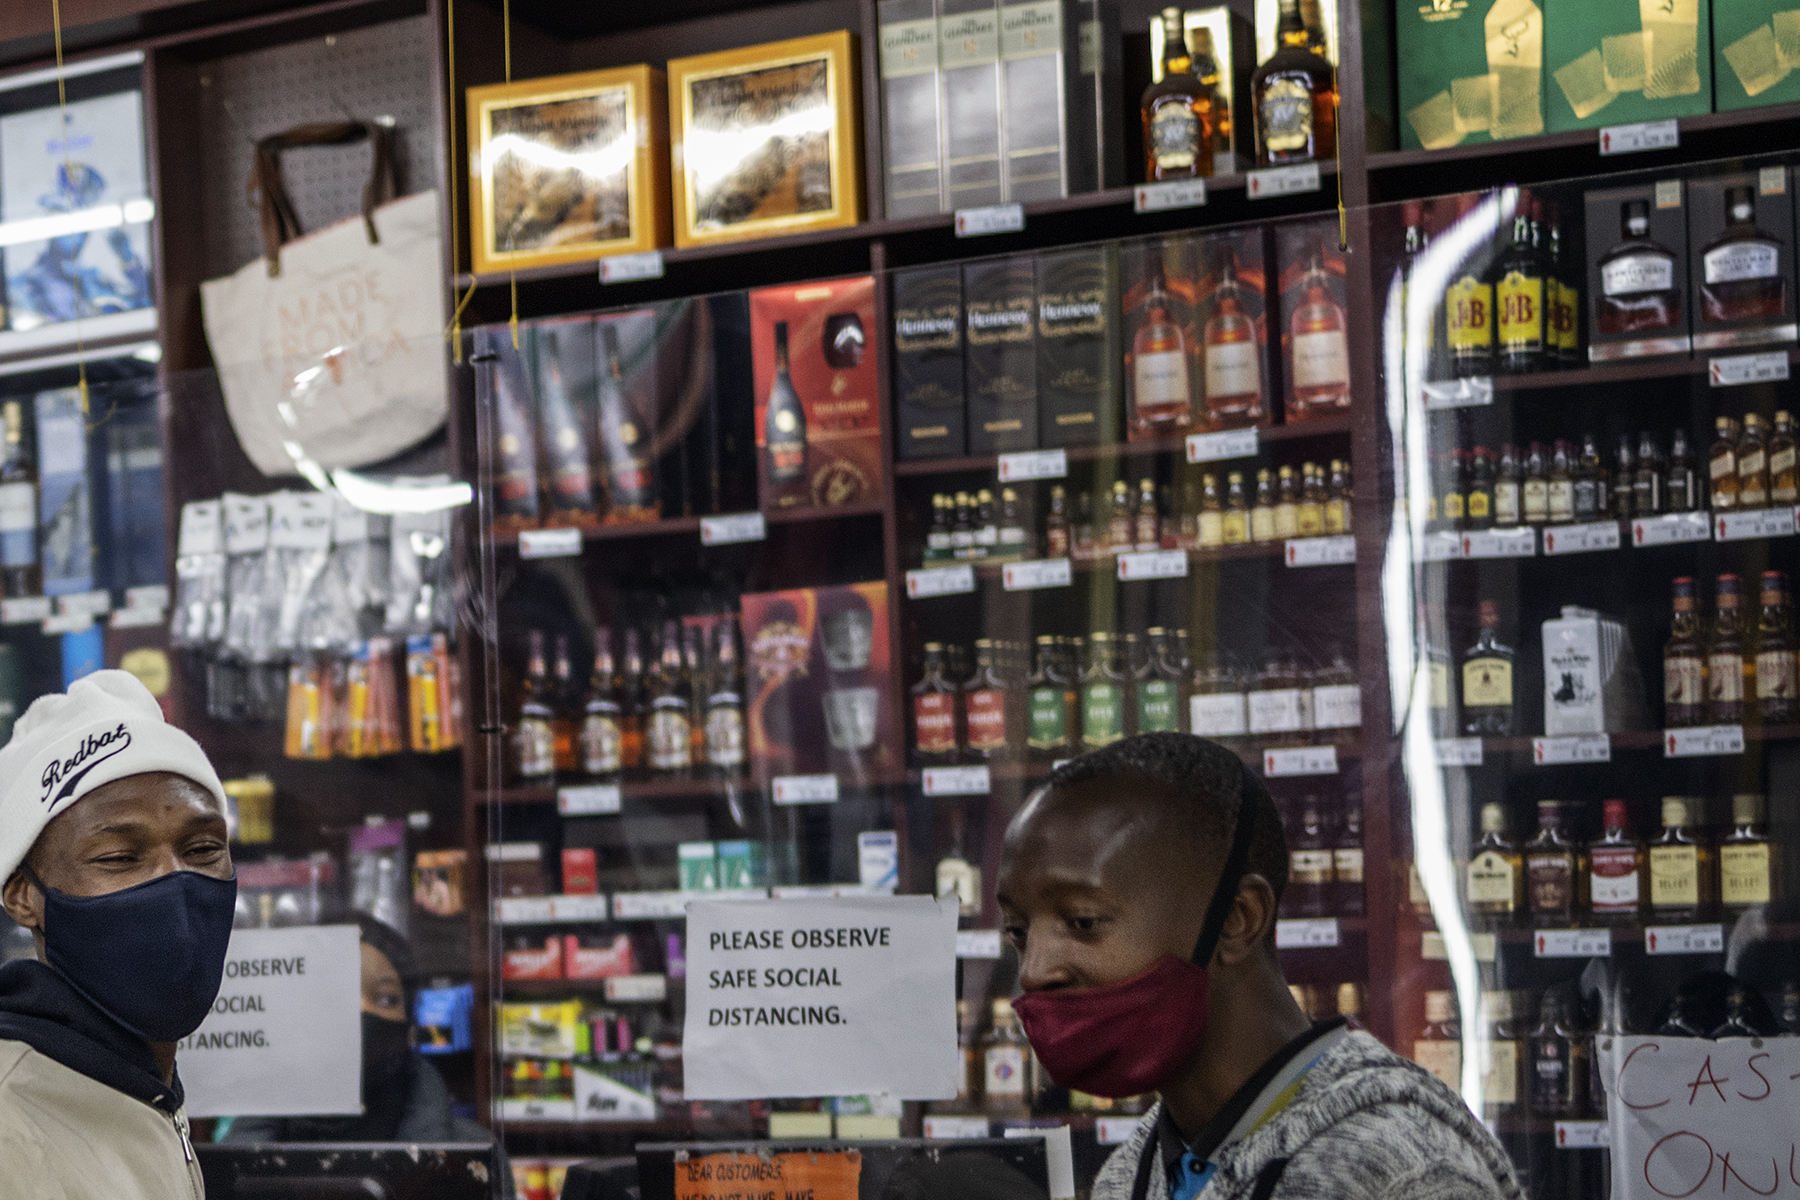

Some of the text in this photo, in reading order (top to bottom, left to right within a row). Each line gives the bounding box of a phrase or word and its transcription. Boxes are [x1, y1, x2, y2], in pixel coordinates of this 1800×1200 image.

[41, 723, 131, 805] Redbat
[710, 927, 891, 950] PLEASE OBSERVE
[226, 957, 306, 979] OBSERVE
[709, 967, 842, 989] SAFE SOCIAL
[209, 995, 266, 1014] OCIAL
[708, 1006, 847, 1026] DISTANCING.
[1617, 1043, 1800, 1110] CAS
[687, 1164, 712, 1182] DEAR
